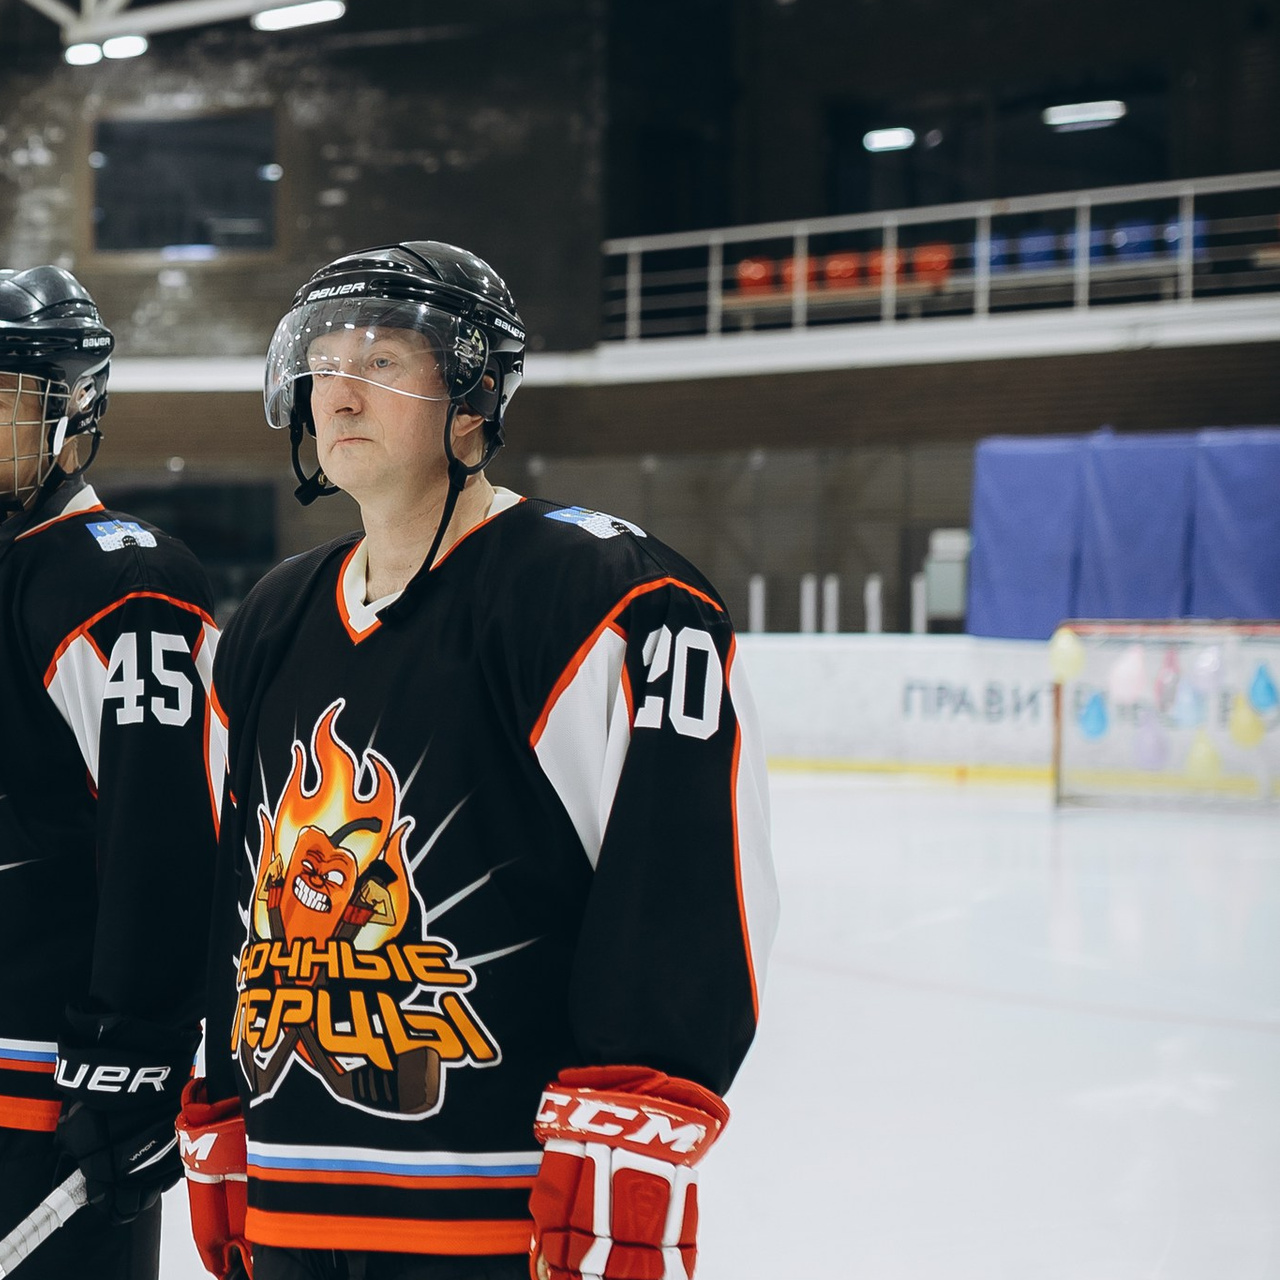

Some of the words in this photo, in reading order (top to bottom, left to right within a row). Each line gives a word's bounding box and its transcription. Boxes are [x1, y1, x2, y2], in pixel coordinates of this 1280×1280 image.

[307, 280, 365, 302] BAUER
[82, 337, 111, 348] BAUER
[494, 318, 526, 341] BAUER
[102, 631, 194, 727] 45
[632, 624, 724, 739] 20
[240, 939, 468, 985] НОЧНЫЕ
[56, 1058, 172, 1094] UER
[535, 1091, 707, 1154] CCM
